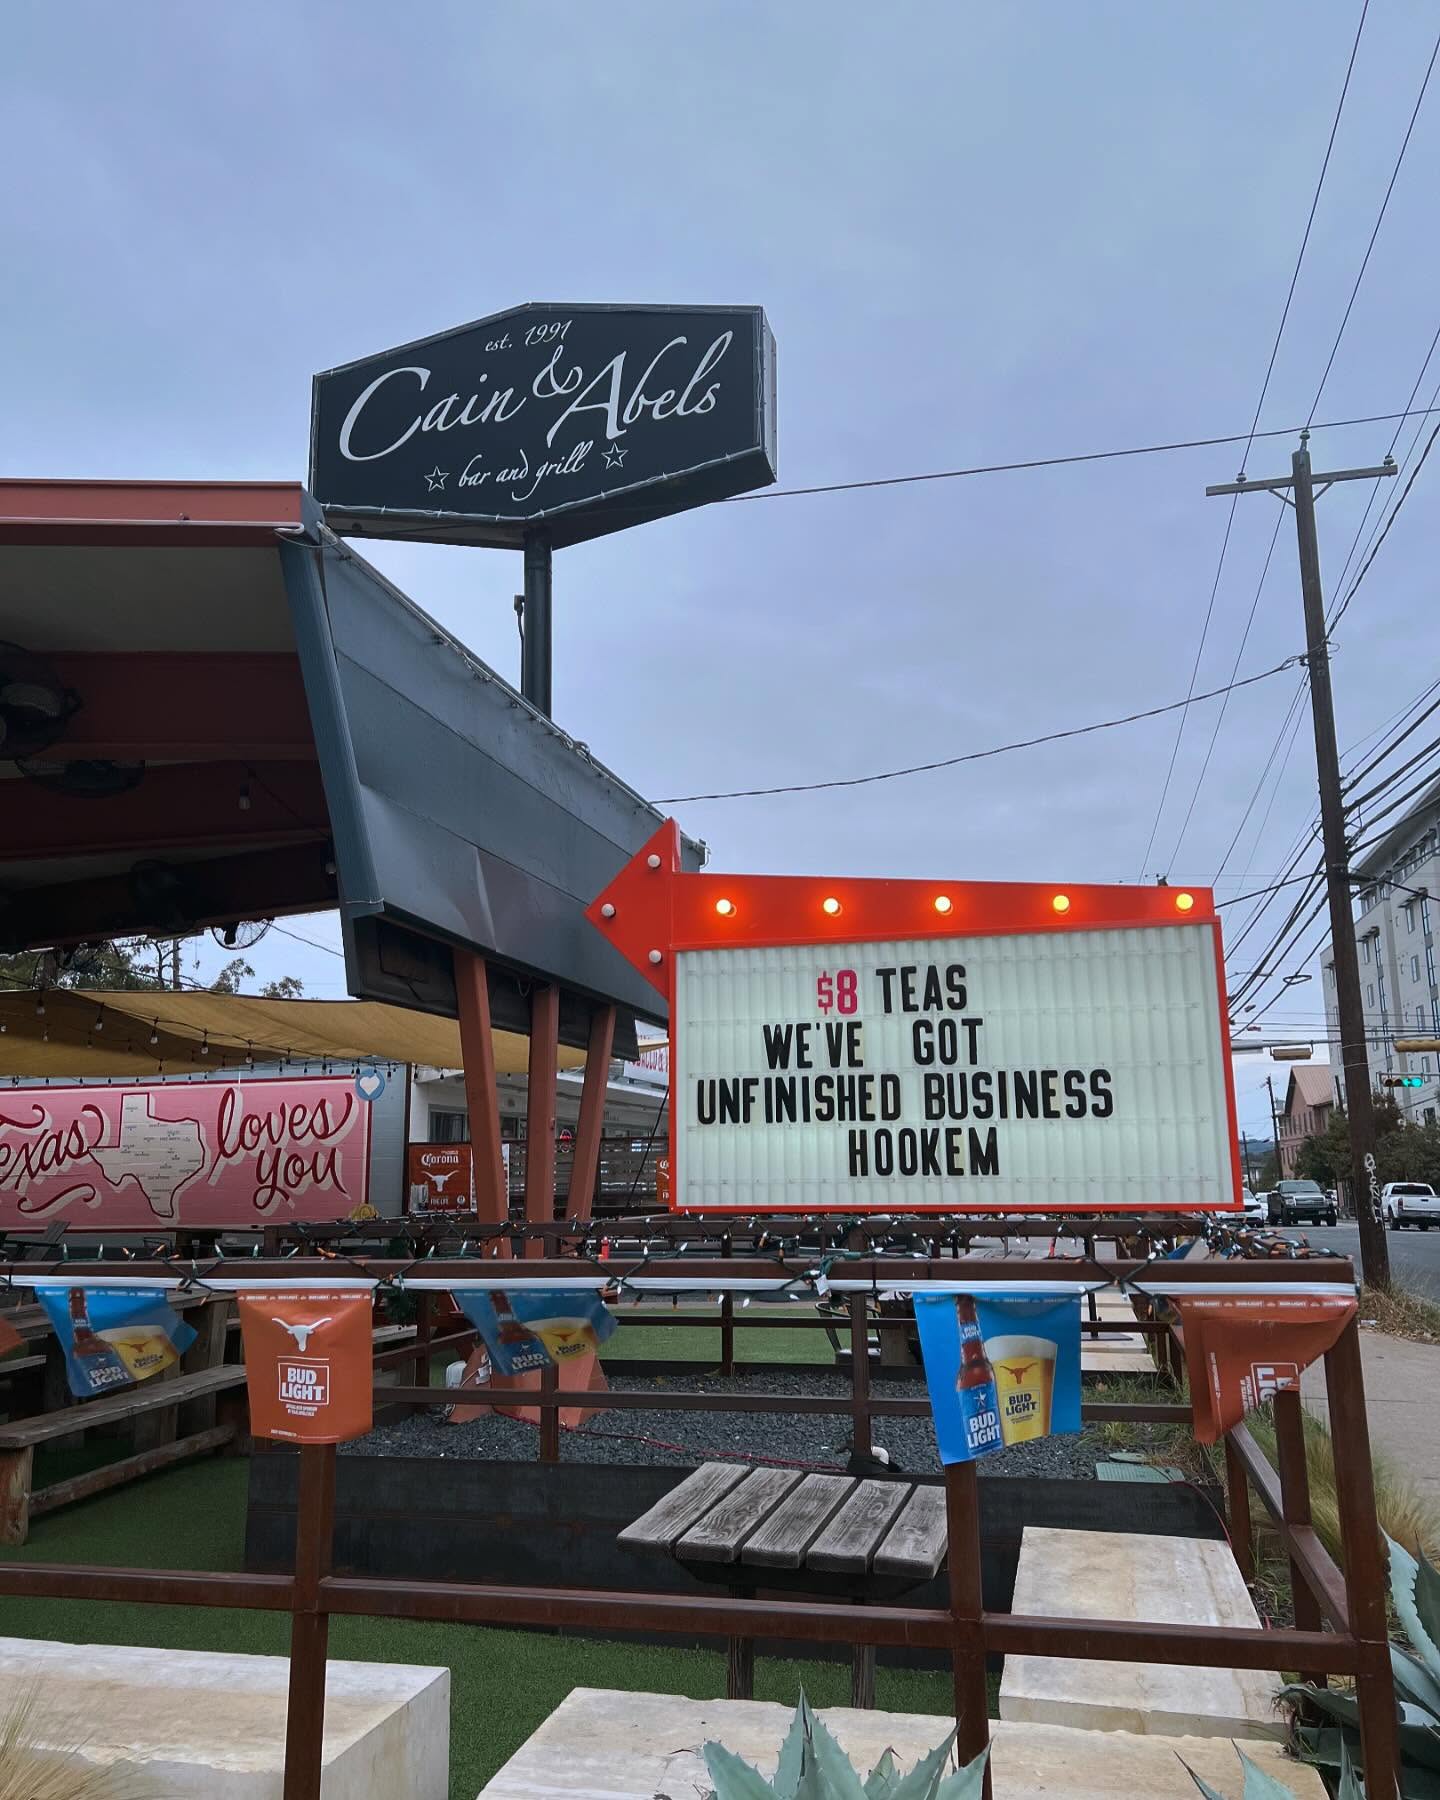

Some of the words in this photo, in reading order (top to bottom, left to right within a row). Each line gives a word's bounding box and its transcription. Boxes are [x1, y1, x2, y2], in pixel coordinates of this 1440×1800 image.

[485, 332, 512, 353] est.
[524, 319, 573, 347] 1991
[532, 344, 583, 398] &
[546, 330, 734, 449] Abels
[338, 367, 527, 462] Cain
[458, 454, 490, 487] bar
[495, 448, 529, 483] and
[511, 440, 594, 502] grill
[817, 969, 858, 1015] $8
[876, 964, 968, 1014] TEAS
[763, 1020, 864, 1070] WE'VE
[912, 1017, 984, 1066] GOT
[696, 1072, 901, 1125] UNFINISHED
[923, 1068, 1114, 1120] BUSINESS
[0, 1103, 104, 1190] exas
[207, 1087, 353, 1182] loves
[847, 1126, 1000, 1177] HOOKEM
[252, 1147, 348, 1210] you
[421, 1153, 459, 1168] Corona
[281, 1382, 325, 1401] LIGHT
[287, 1367, 318, 1385] BUD
[1005, 1401, 1037, 1417] LIGHT
[1008, 1392, 1033, 1406] BUD
[967, 1424, 1001, 1449] LIGHT
[969, 1411, 996, 1433] BUD
